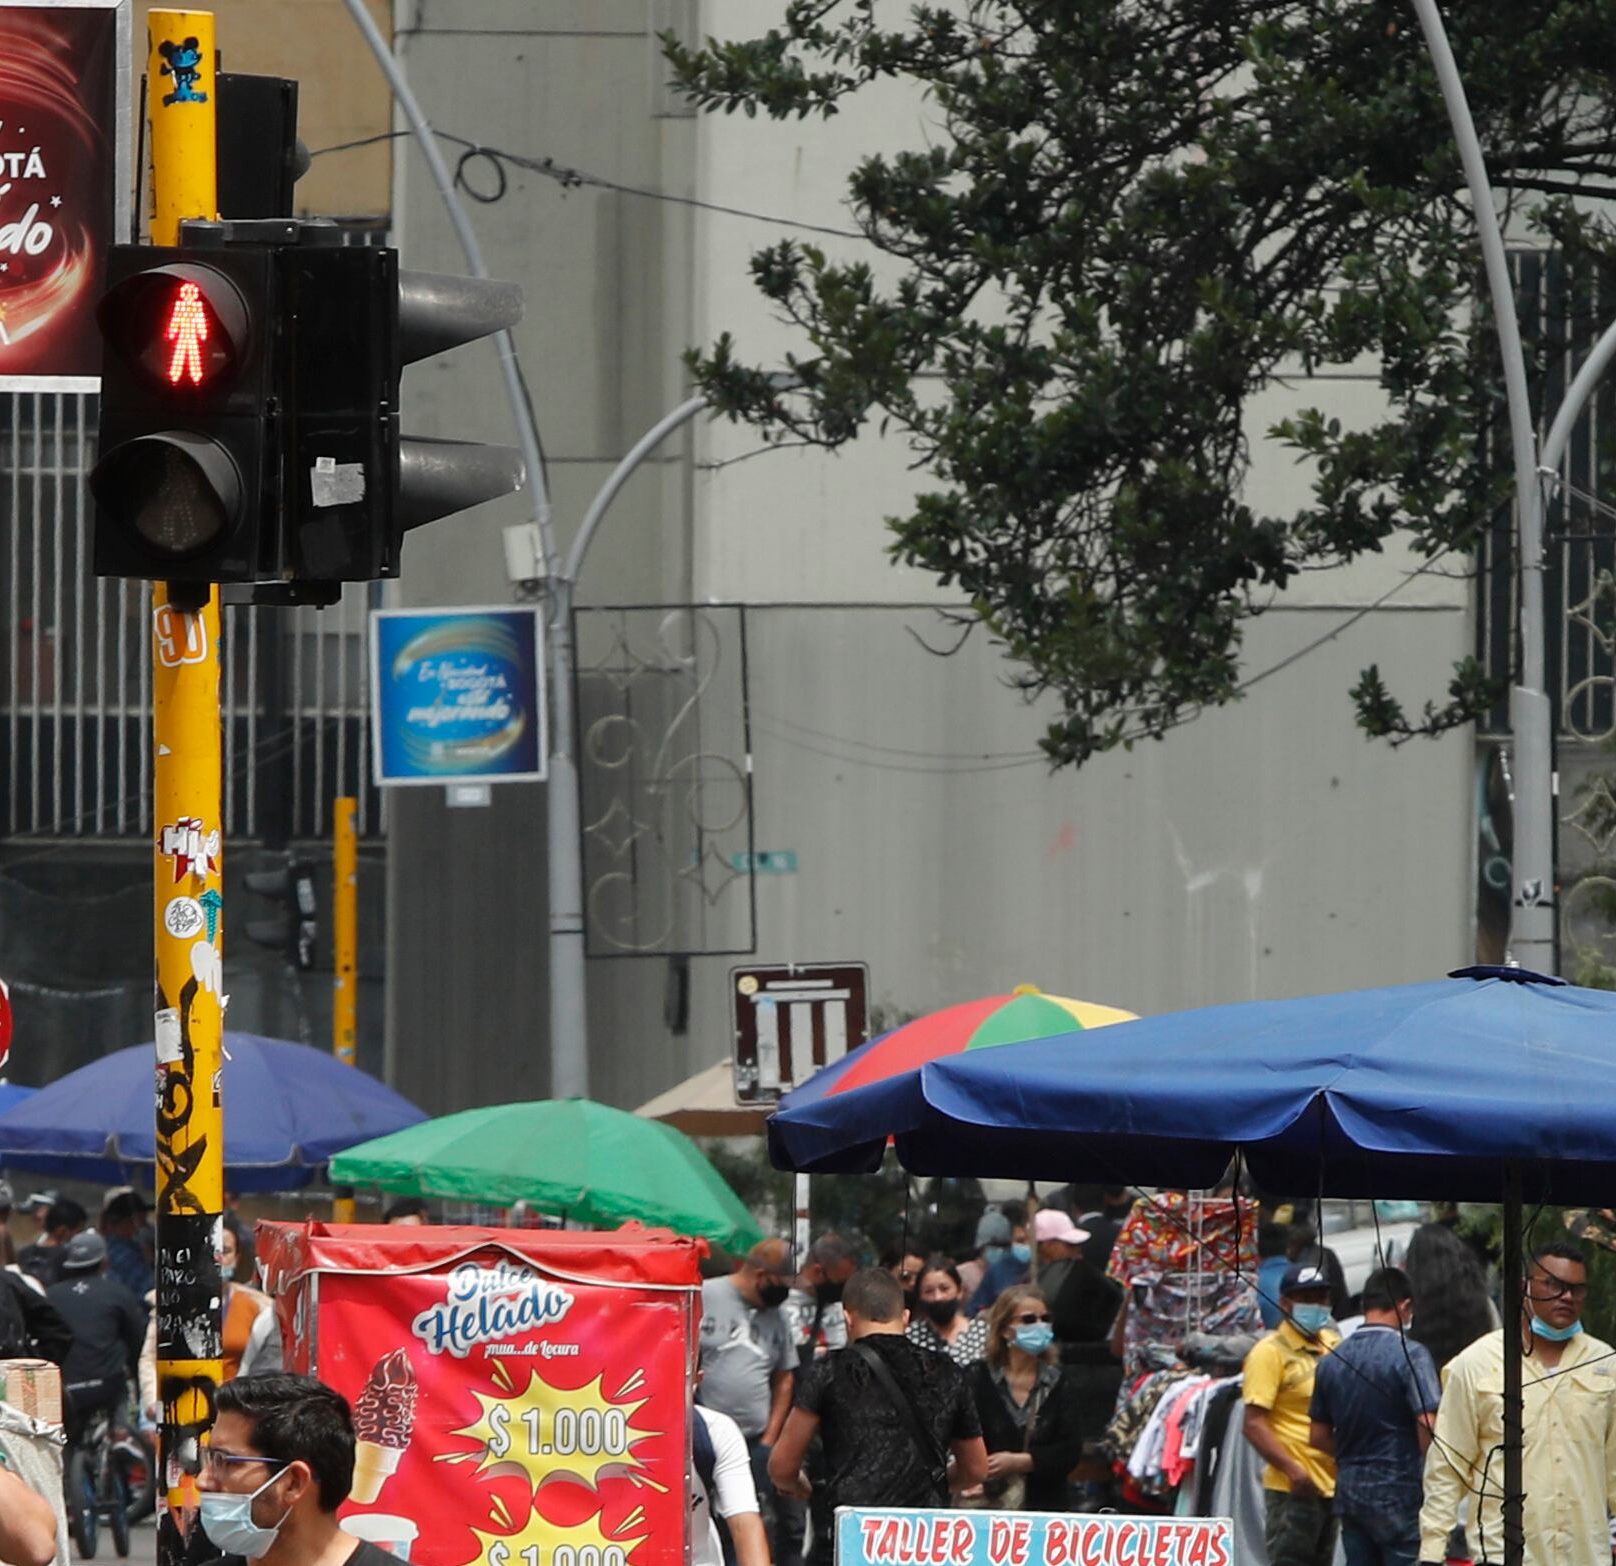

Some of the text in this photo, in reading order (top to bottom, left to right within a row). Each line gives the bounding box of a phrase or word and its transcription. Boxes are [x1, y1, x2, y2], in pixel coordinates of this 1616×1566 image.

[455, 1263, 533, 1301] Dulce
[418, 1283, 568, 1354] Helado
[489, 1405, 628, 1457] $ 1.000
[860, 1516, 975, 1565] TALLER
[988, 1518, 1032, 1566] DE
